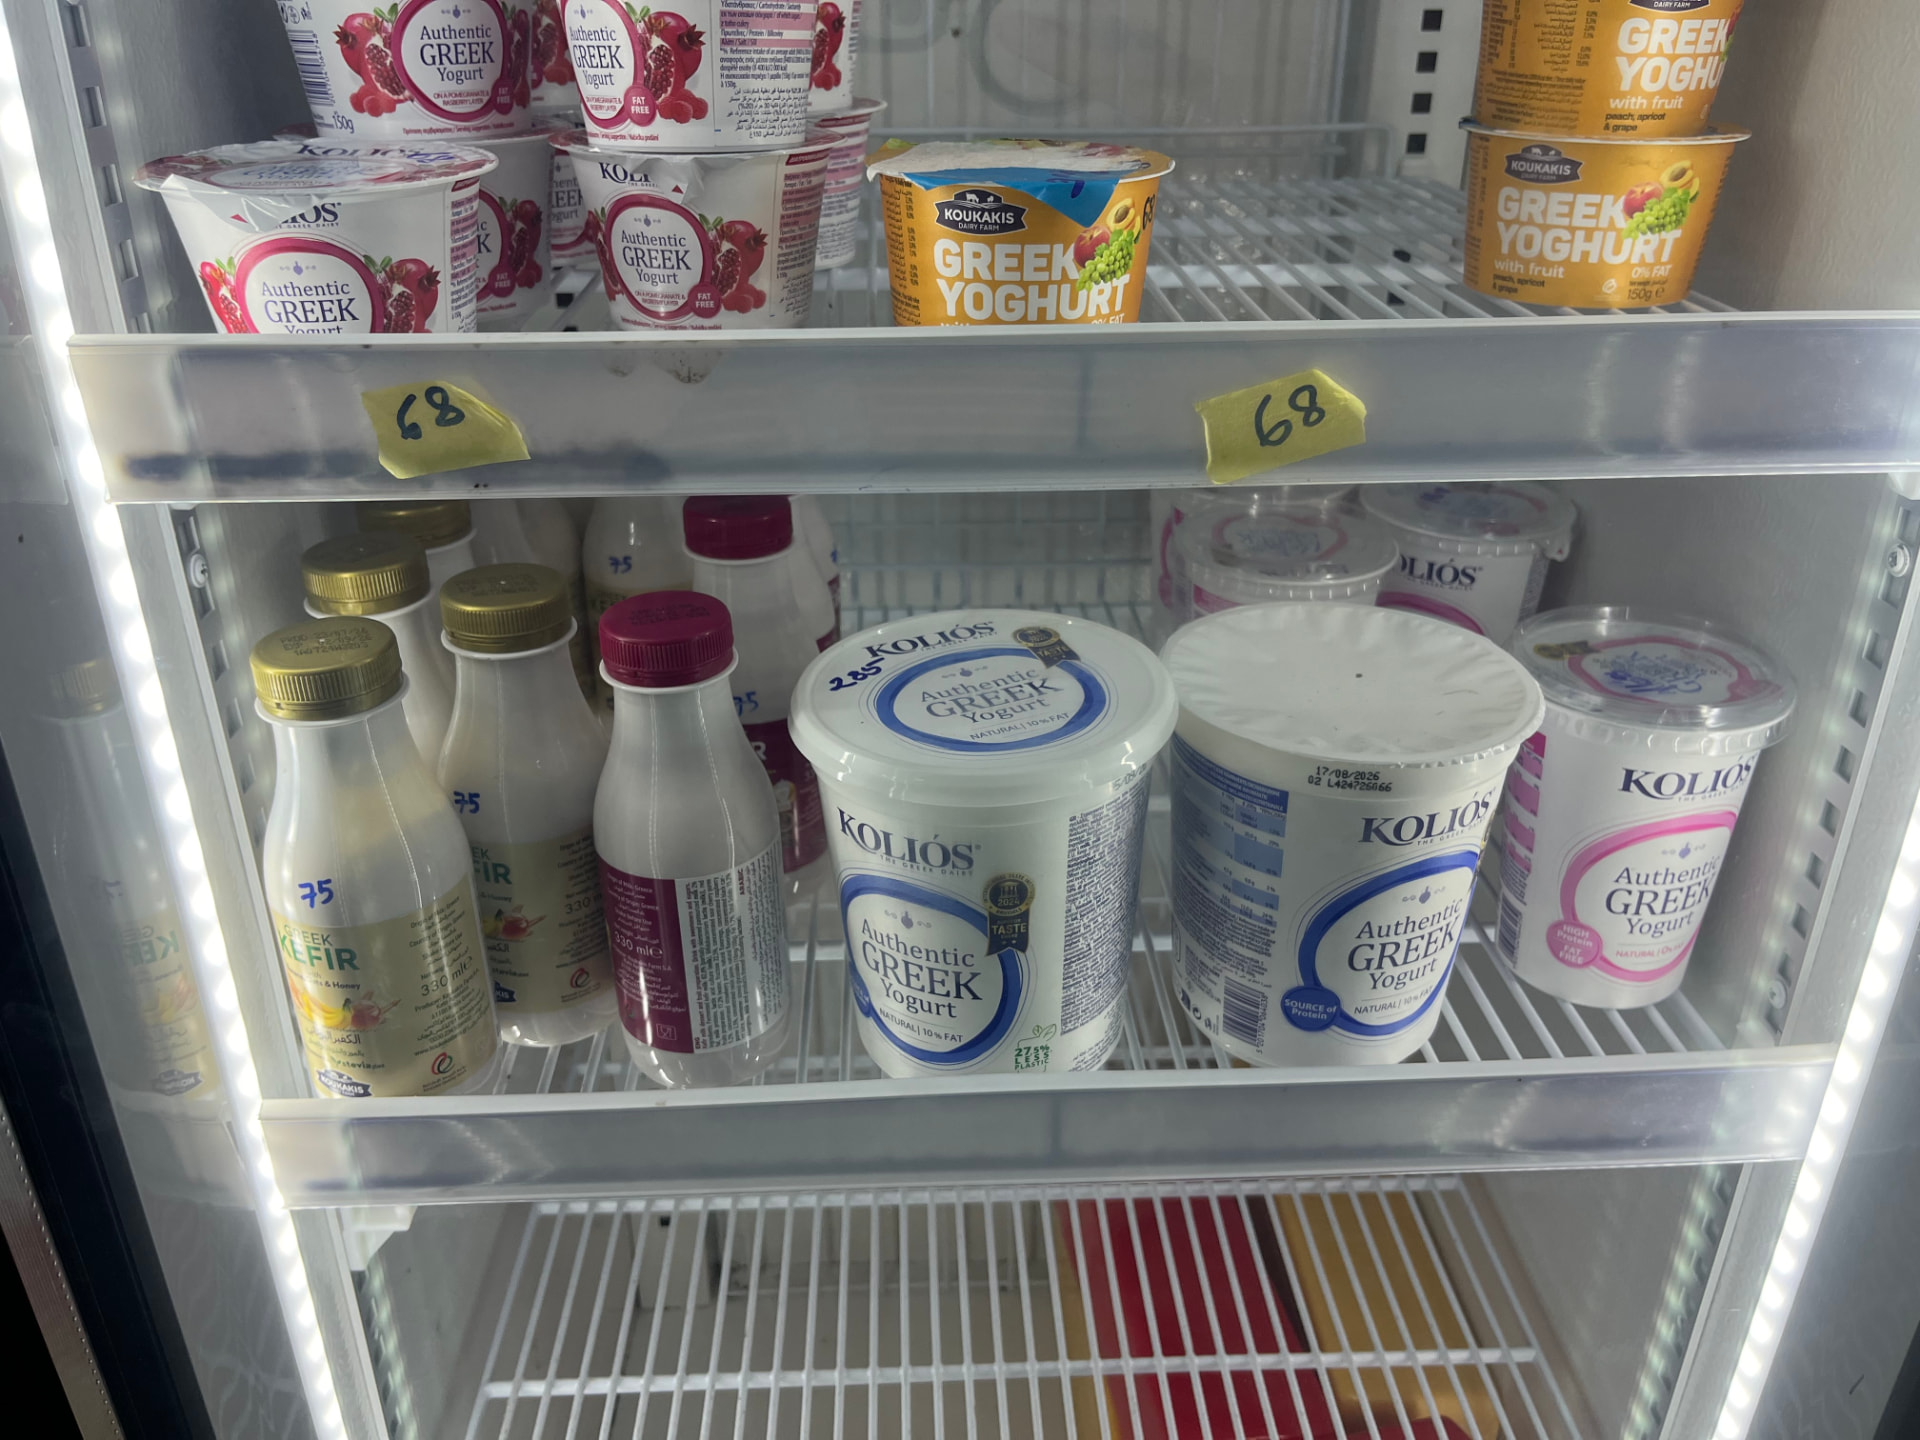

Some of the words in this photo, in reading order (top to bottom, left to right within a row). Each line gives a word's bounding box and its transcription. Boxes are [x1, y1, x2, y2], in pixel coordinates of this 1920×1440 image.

[1654, 1, 1672, 9] DAIRY
[1673, 1, 1691, 9] FARM
[420, 25, 492, 41] Authentic
[570, 26, 616, 43] Authentic
[1617, 17, 1730, 55] GREEK
[420, 41, 495, 67] GREEK
[573, 45, 624, 70] GREEK
[436, 67, 484, 85] Yogurt
[582, 69, 614, 89] Yogurt
[1615, 56, 1726, 92] YOGHU
[631, 106, 650, 114] FREE
[632, 96, 646, 105] FAT
[1609, 96, 1648, 110] with
[1651, 96, 1684, 110] fruit
[332, 114, 355, 133] 150g
[1605, 112, 1635, 123] peach,
[1637, 112, 1666, 123] apricot
[1612, 123, 1638, 133] grape
[1511, 160, 1571, 175] KOUKAKIS
[943, 206, 1015, 225] KOUKAKIS
[1497, 186, 1627, 229] GREEK
[958, 222, 978, 231] DAIRY
[979, 223, 1000, 232] FARM
[620, 229, 686, 250] Authentic
[1497, 222, 1682, 265] YOGHURT
[622, 246, 692, 272] GREEK
[933, 238, 1080, 282] GREEK
[1494, 257, 1524, 275] with
[1528, 259, 1565, 279] fruit
[635, 269, 680, 287] Yogurt
[1493, 274, 1516, 285] peach,
[1517, 277, 1546, 288] apricot
[1631, 266, 1652, 279] 0%
[1652, 264, 1672, 277] FAT
[261, 281, 350, 299] Authentic
[697, 292, 711, 300] FAT
[936, 273, 1130, 322] YOGHURT
[1499, 285, 1519, 294] grape
[1627, 288, 1652, 300] 150g
[264, 298, 359, 325] GREEK
[695, 300, 715, 309] FREE
[396, 385, 466, 441] 68
[1254, 384, 1326, 447] 68
[608, 555, 633, 575] 75
[1400, 554, 1476, 586] LIÓS
[864, 622, 995, 659] KOLIÓS
[829, 656, 884, 692] 285
[921, 667, 1040, 703] Authentic
[925, 677, 1065, 719] GREEK
[960, 698, 1051, 724] Yogurt
[970, 724, 1020, 740] NATURAL
[1049, 712, 1070, 722] FAT
[1307, 775, 1322, 786] 02
[1316, 765, 1381, 780] 17/08/2026
[1618, 754, 1754, 801] KOLIÓS
[453, 791, 480, 814] 75
[1358, 790, 1494, 847] KOLIÓS
[837, 806, 975, 871] KOLIÓS
[1417, 838, 1434, 846] THE
[880, 854, 896, 865] THE
[902, 862, 933, 873] GREEK
[940, 868, 974, 877] DAIRY
[1613, 855, 1720, 887] Authentic
[737, 868, 745, 895] ARABIC
[298, 878, 335, 908] 75
[998, 898, 1020, 907] 2024
[1605, 873, 1714, 917] GREEK
[992, 922, 1028, 935] TASTE
[1355, 898, 1463, 940] Authentic
[1626, 911, 1694, 939] Yogurt
[284, 924, 333, 947] GEEK
[614, 930, 634, 950] 330
[1557, 929, 1593, 947] Protein
[1563, 923, 1590, 939] HIGH
[279, 931, 360, 971] KEFIR
[861, 918, 975, 968] Authentic
[1348, 914, 1460, 972] GREEK
[1563, 944, 1581, 956] FAT
[1615, 949, 1655, 958] NATURAL
[1559, 950, 1584, 965] FREE
[862, 941, 983, 1001] GREEK
[1369, 956, 1438, 990] Yogurt
[332, 980, 361, 991] Honey
[421, 974, 449, 997] 330
[880, 978, 957, 1018] Yogurt
[1284, 997, 1325, 1013] SOURCE
[1326, 1004, 1337, 1013] of
[1354, 1000, 1397, 1015] NATURAL
[1291, 1006, 1328, 1020] Protein
[880, 1008, 917, 1033] NATURAL
[944, 1033, 964, 1043] FAT
[1015, 1051, 1050, 1065] LESS
[1015, 1058, 1049, 1071] PLASTIC
